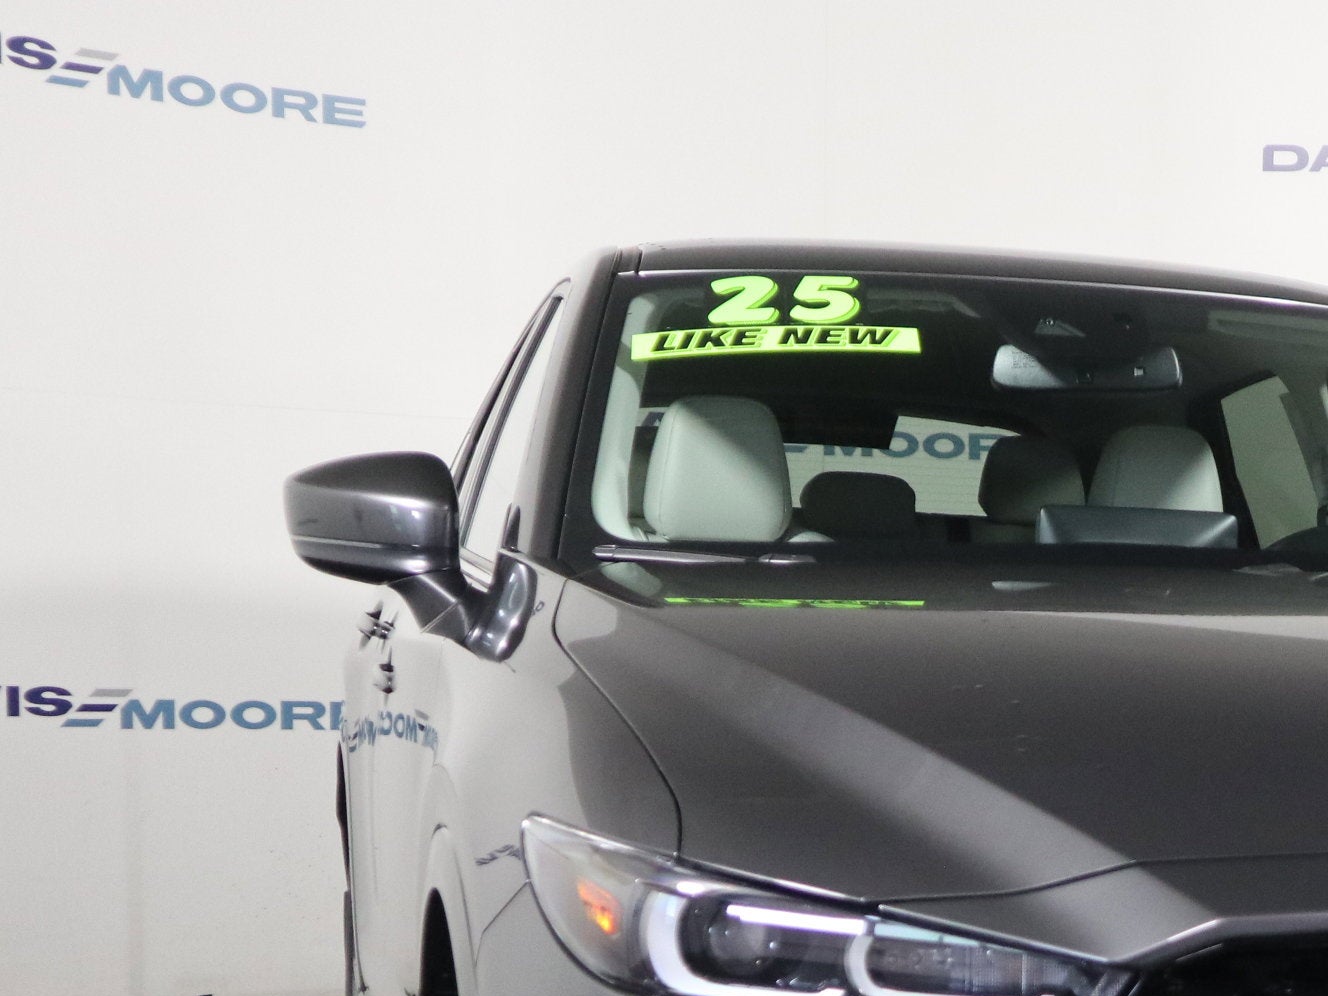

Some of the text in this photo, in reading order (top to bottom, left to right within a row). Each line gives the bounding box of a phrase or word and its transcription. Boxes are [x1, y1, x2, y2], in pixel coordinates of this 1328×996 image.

[107, 64, 367, 129] MOORE
[707, 275, 862, 325] 25
[650, 326, 900, 352] LIKE NEW
[120, 699, 342, 731] MOOR
